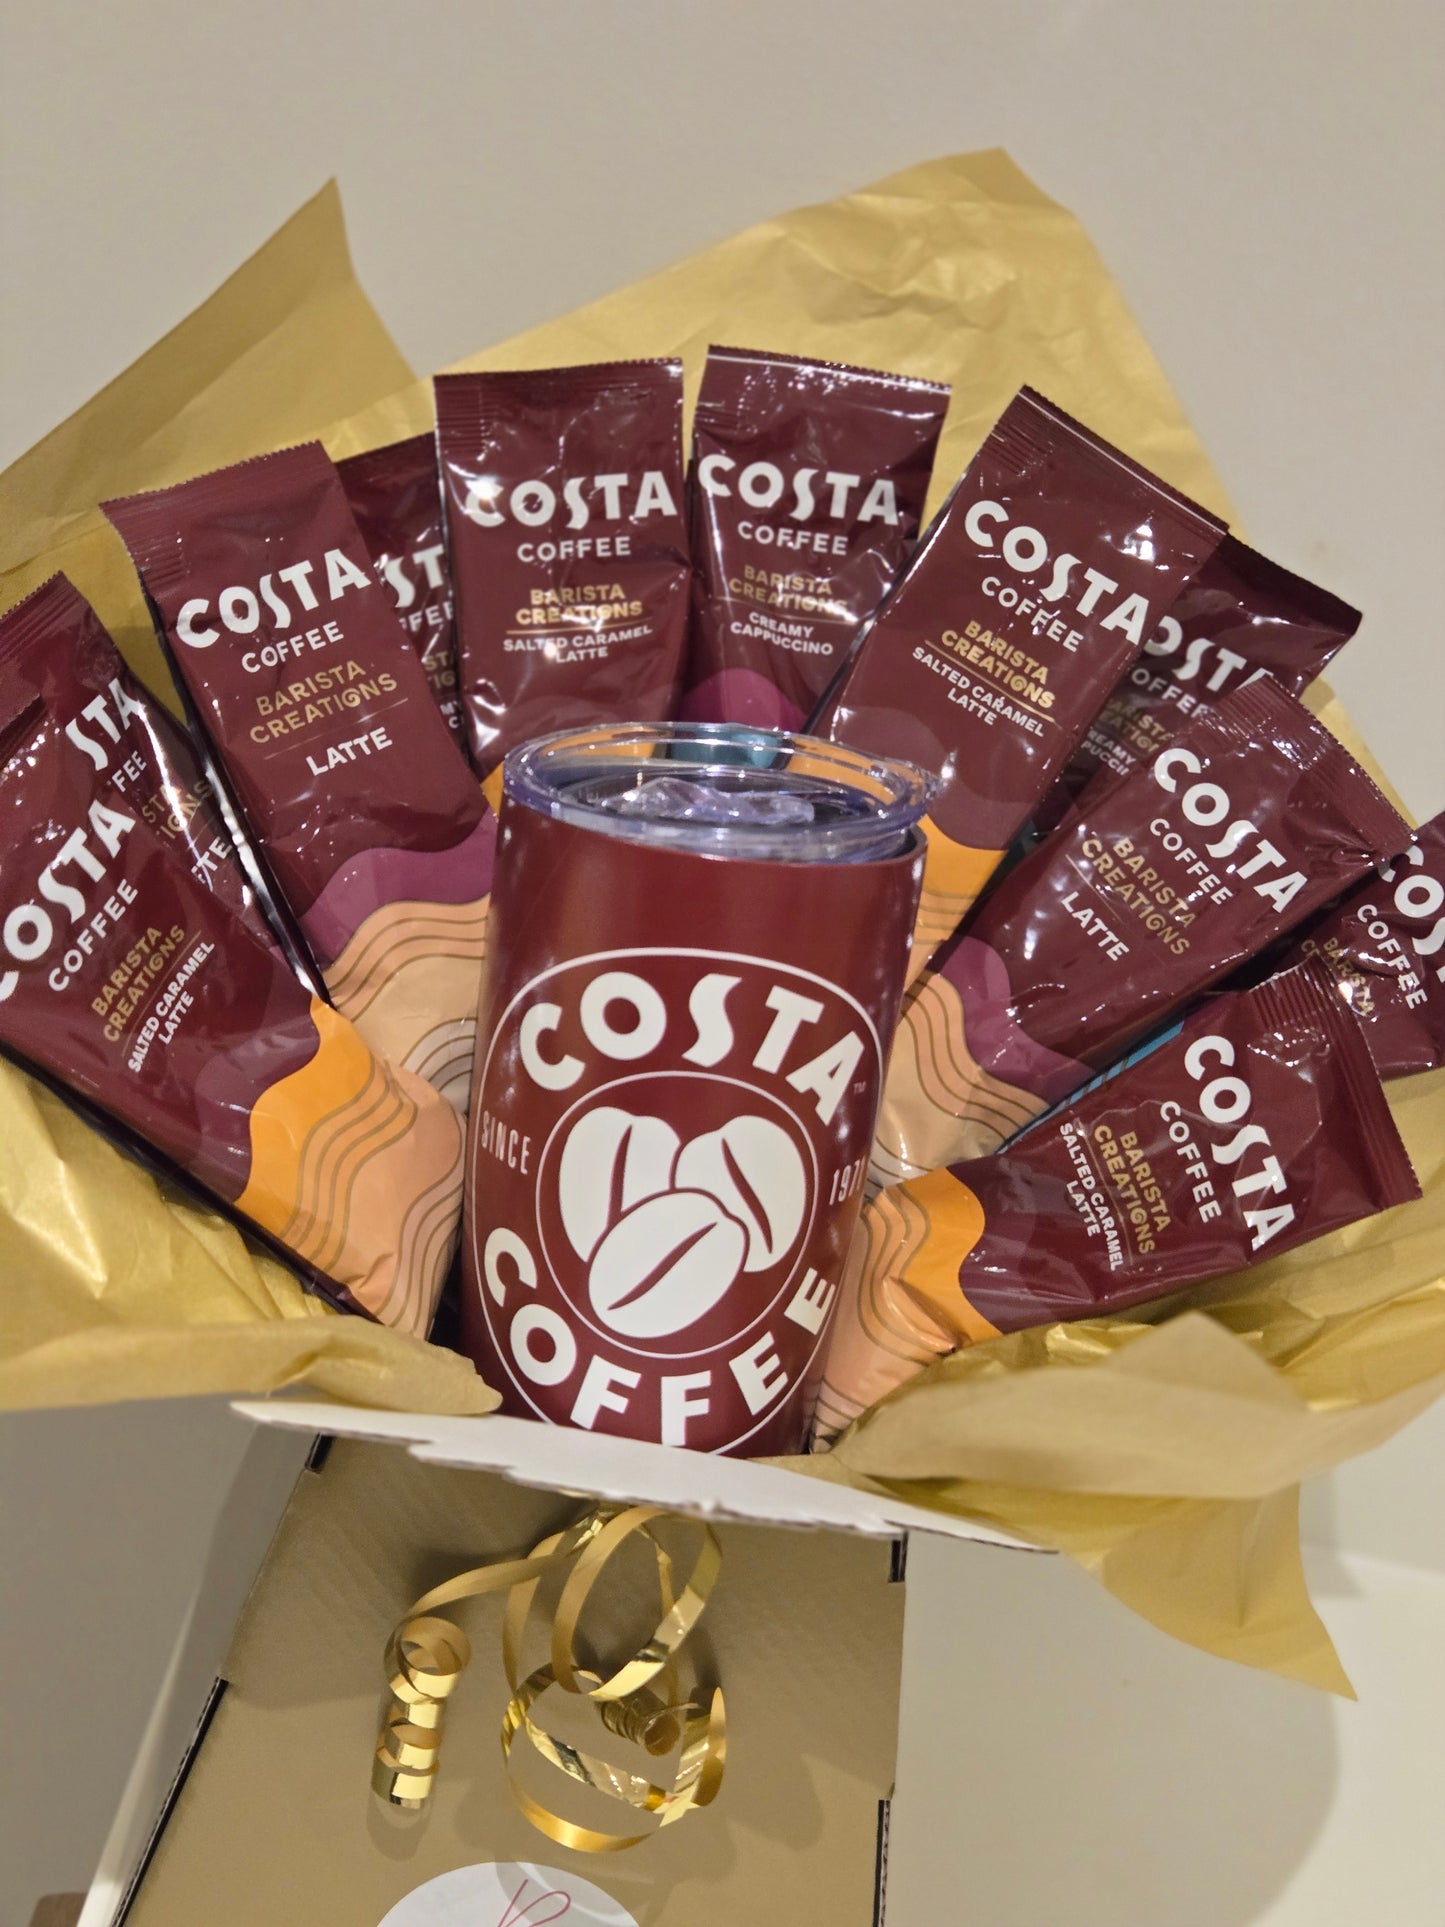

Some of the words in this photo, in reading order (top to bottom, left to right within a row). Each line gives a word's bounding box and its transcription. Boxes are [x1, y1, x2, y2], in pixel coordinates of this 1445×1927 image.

[465, 471, 677, 530] COSTA
[698, 454, 898, 526] COSTA
[517, 536, 631, 562] COFFEE
[737, 521, 848, 556] COFFEE
[965, 500, 1150, 645] COSTA
[176, 549, 371, 648] COSTA
[530, 583, 626, 606] BARISTA
[744, 565, 832, 595] BARISTA
[981, 576, 1084, 653] COFFEE
[242, 621, 344, 673] COFFEE
[556, 647, 608, 663] LATTE
[572, 625, 653, 647] CARAMEL
[730, 621, 833, 655] CAPPUCCINO
[749, 612, 814, 639] CREAMY
[964, 620, 1049, 685] BARISTA
[1144, 616, 1274, 692] OST
[250, 673, 397, 743] CREATIONS
[256, 660, 366, 716] BARISTA
[912, 647, 971, 690] SALTED
[972, 685, 1045, 737] CARAMEL
[941, 630, 1056, 709] CREATIONS
[947, 688, 997, 725] LATTE
[65, 678, 146, 771] STA
[306, 727, 393, 775] LATTE
[1150, 818, 1233, 905] COFFEE
[1154, 748, 1308, 913] COSTA
[1082, 839, 1190, 955] CREATIONS
[1113, 838, 1196, 928] BARISTA
[49, 879, 138, 991] COFFEE
[1061, 891, 1130, 961] LATTE
[1357, 904, 1428, 1009] COFFEE
[91, 927, 162, 1016] BARISTA
[103, 925, 185, 1042] CREATIONS
[127, 1016, 159, 1073] SALTED
[156, 941, 215, 1017] CARAMEL
[158, 990, 194, 1045] LATTE
[520, 971, 864, 1126] COSTA
[481, 1110, 531, 1176] SINCE
[1120, 1131, 1171, 1232] BARISTA
[1160, 1101, 1222, 1223] COFFEE
[1184, 1035, 1295, 1251] COSTA
[1060, 1122, 1095, 1190] SALTED
[1091, 1192, 1124, 1272] CARAMEL
[1066, 1180, 1100, 1237] LATTE
[1094, 1125, 1155, 1254] CREATIONS
[484, 1227, 836, 1447] COFFEE
